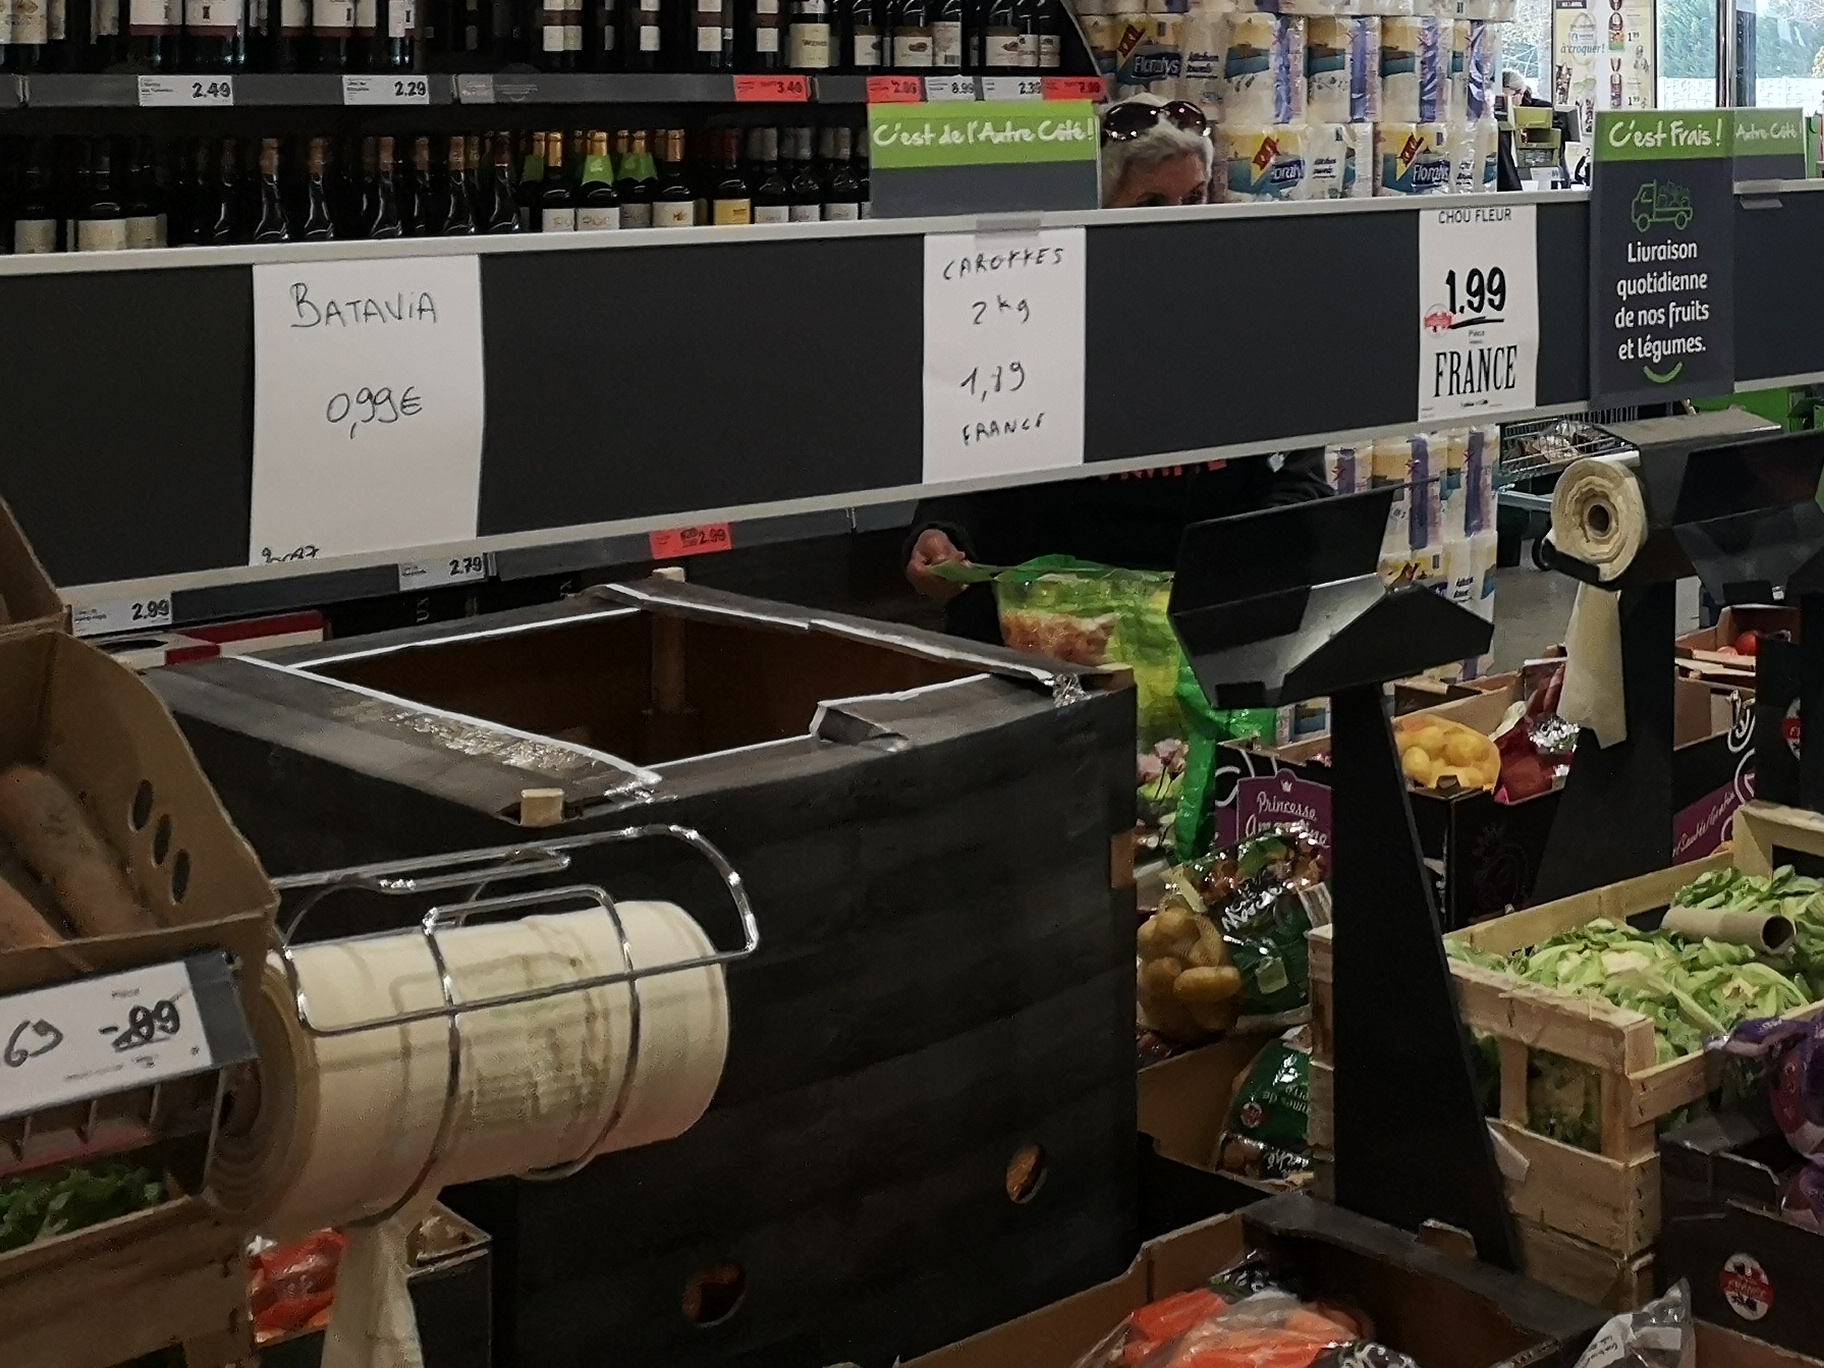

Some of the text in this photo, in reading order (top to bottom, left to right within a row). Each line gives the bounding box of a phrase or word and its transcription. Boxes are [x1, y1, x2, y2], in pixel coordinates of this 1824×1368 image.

[191, 81, 232, 99] 2.49
[393, 80, 427, 97] 2.29
[873, 122, 936, 147] C'est
[938, 123, 965, 145] de
[1609, 119, 1666, 148] C'est
[1438, 207, 1512, 224] CHOU FLEUR
[942, 246, 1065, 281] CAROTTES
[1627, 239, 1698, 264] Livraison
[1445, 266, 1506, 314] 1.99
[1616, 271, 1708, 301] quotidienne
[971, 301, 988, 325] 2
[1614, 300, 1710, 329] de nos fruits
[1618, 333, 1707, 364] et légumes.
[1434, 344, 1518, 398] FRANCE
[448, 555, 482, 578] 2.79
[131, 598, 170, 621] 2.99
[1256, 790, 1318, 820] Princesse
